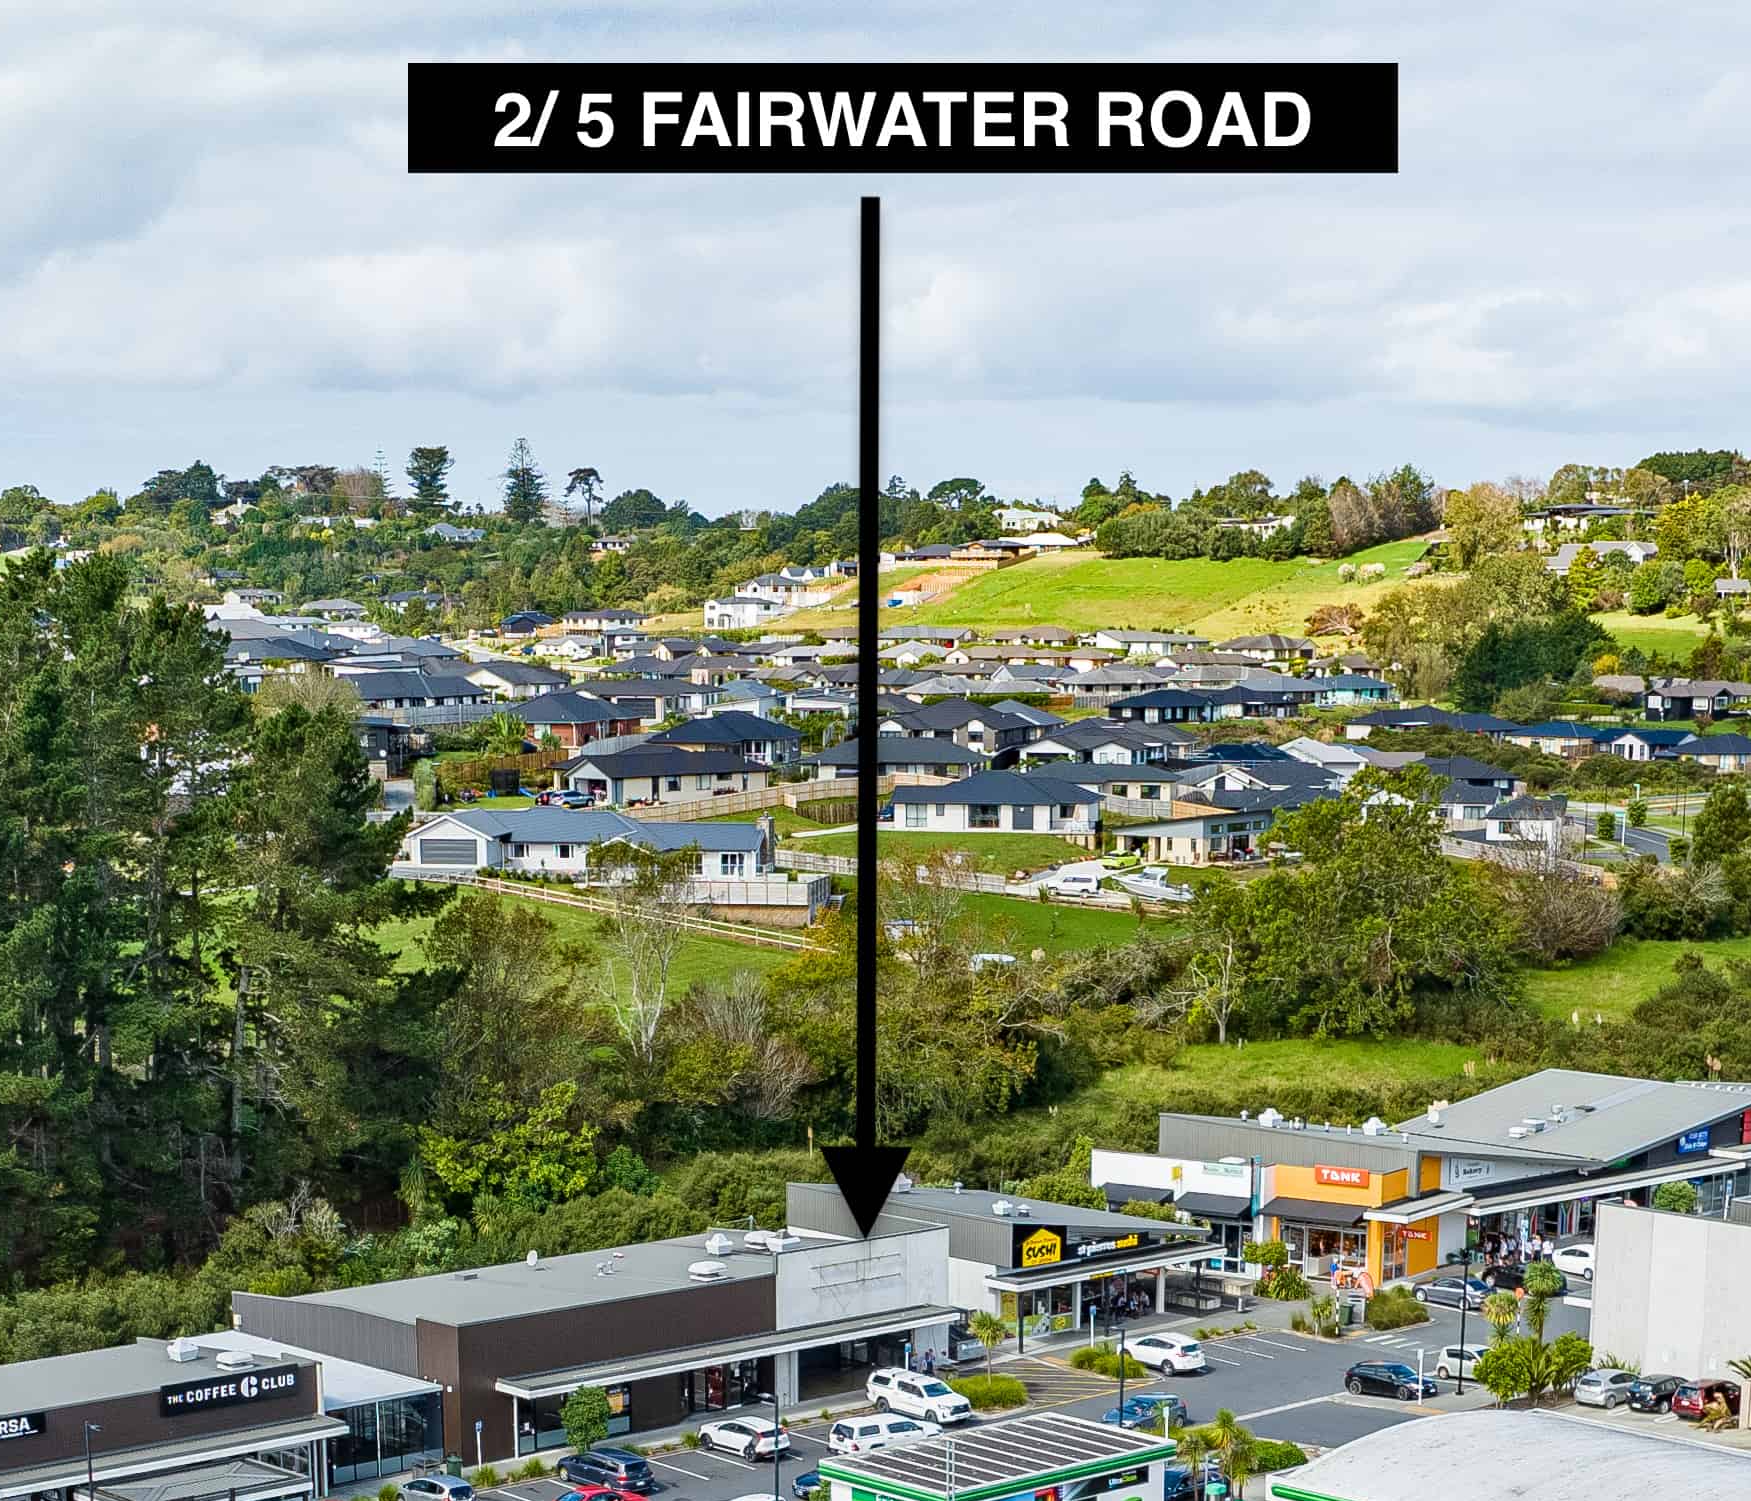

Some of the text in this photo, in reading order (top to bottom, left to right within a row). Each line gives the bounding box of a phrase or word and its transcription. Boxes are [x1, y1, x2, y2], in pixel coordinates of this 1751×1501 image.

[1321, 1169, 1361, 1183] TANK
[1026, 1243, 1057, 1258] SUSHI
[167, 1393, 185, 1405] THE
[186, 1383, 237, 1404] COFFEE
[261, 1373, 296, 1390] CLUB
